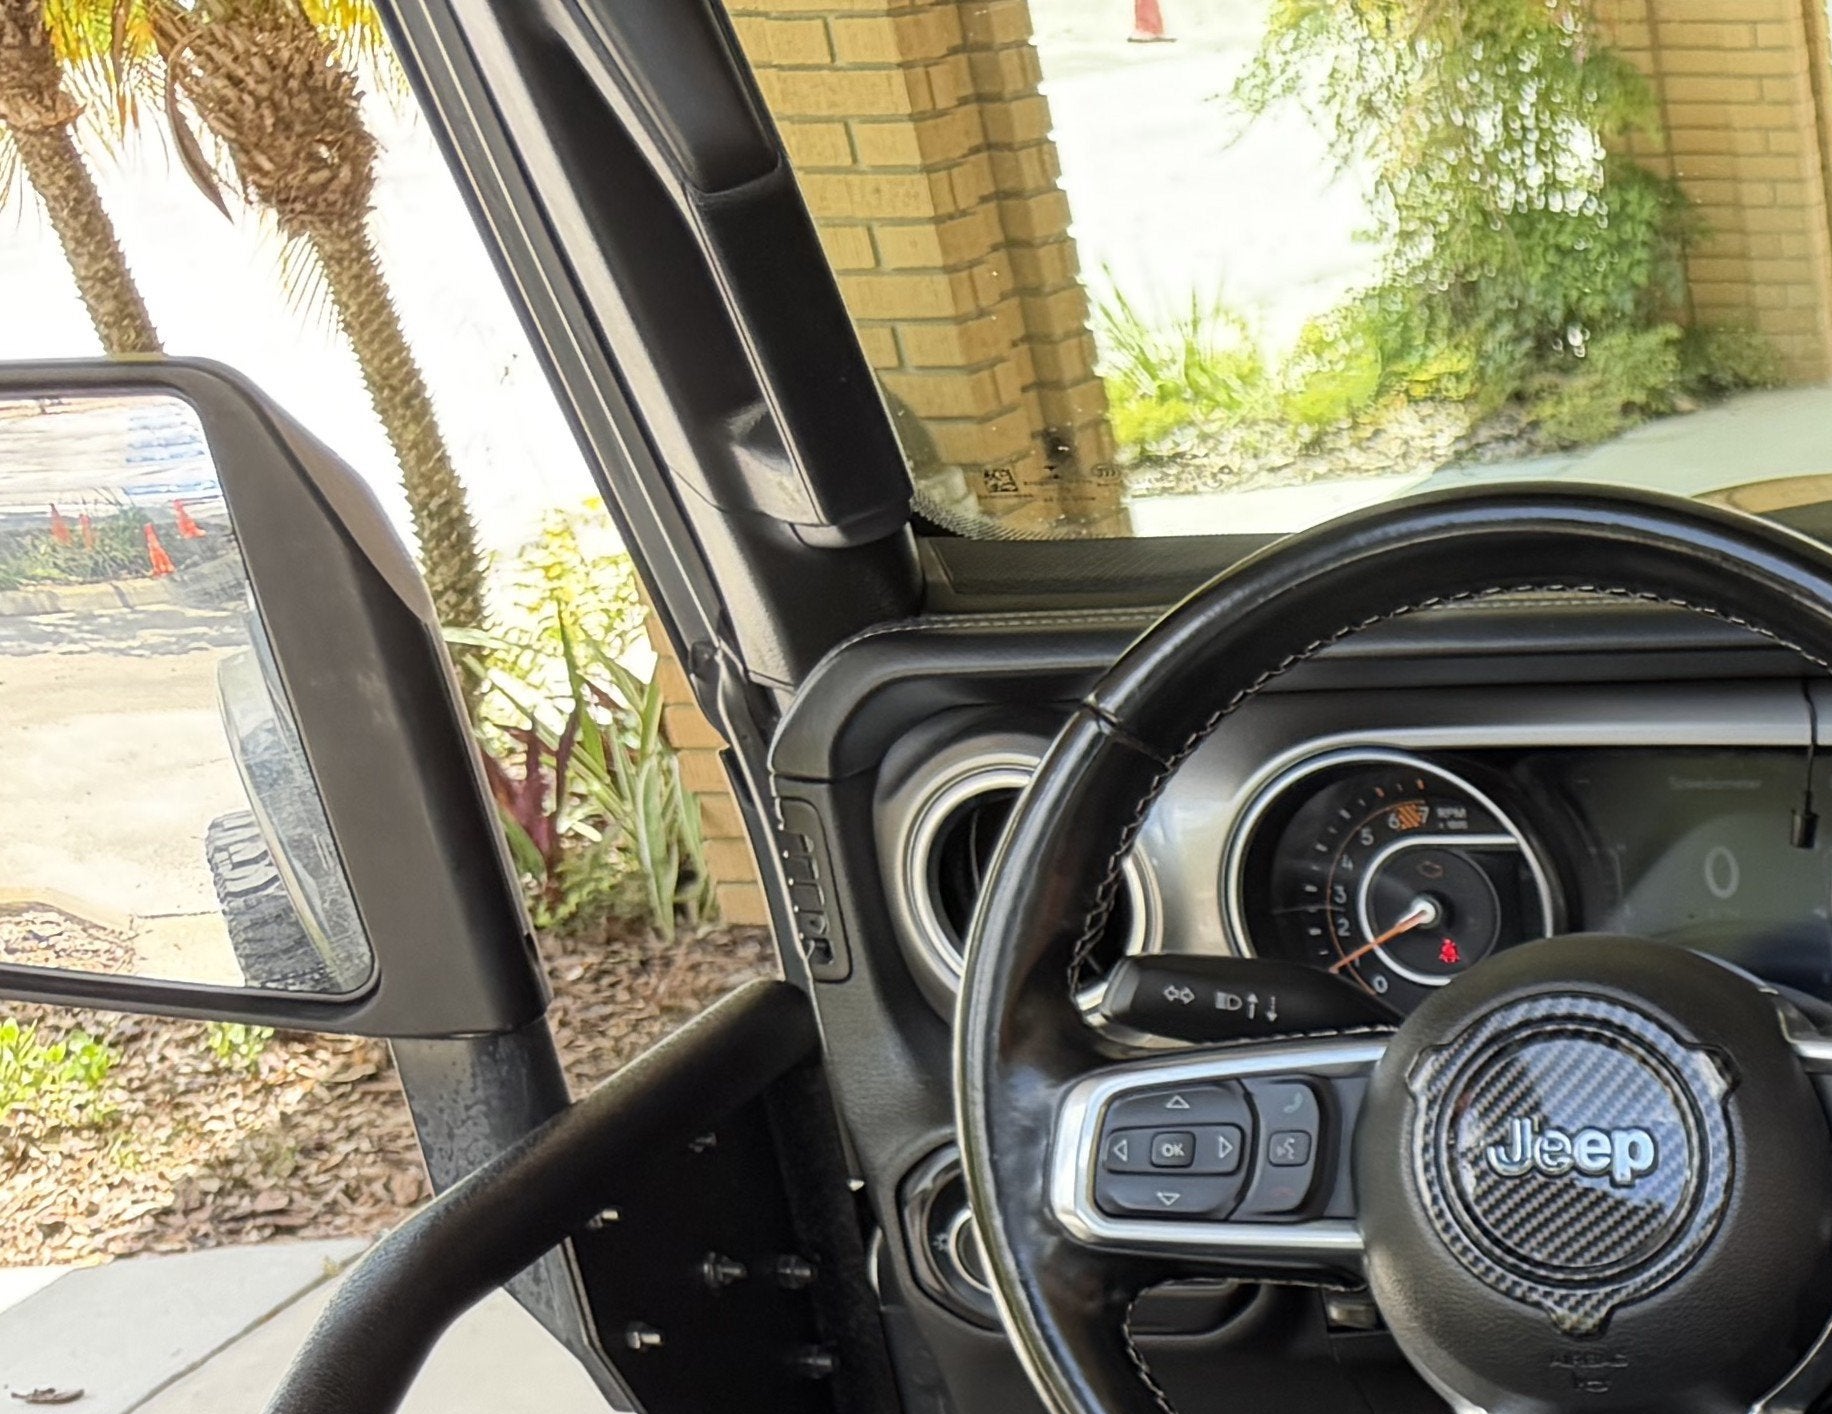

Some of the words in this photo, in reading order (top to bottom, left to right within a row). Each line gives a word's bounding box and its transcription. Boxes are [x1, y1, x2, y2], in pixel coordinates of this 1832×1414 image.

[1388, 812, 1400, 830] 6
[1419, 807, 1430, 824] 7
[1361, 829, 1374, 846] 5
[1703, 845, 1740, 899] 0
[1334, 885, 1347, 902] 3
[1337, 919, 1350, 936] 2
[1373, 975, 1389, 994] 0
[1161, 1143, 1185, 1158] OK
[1486, 1117, 1657, 1186] Jeep
